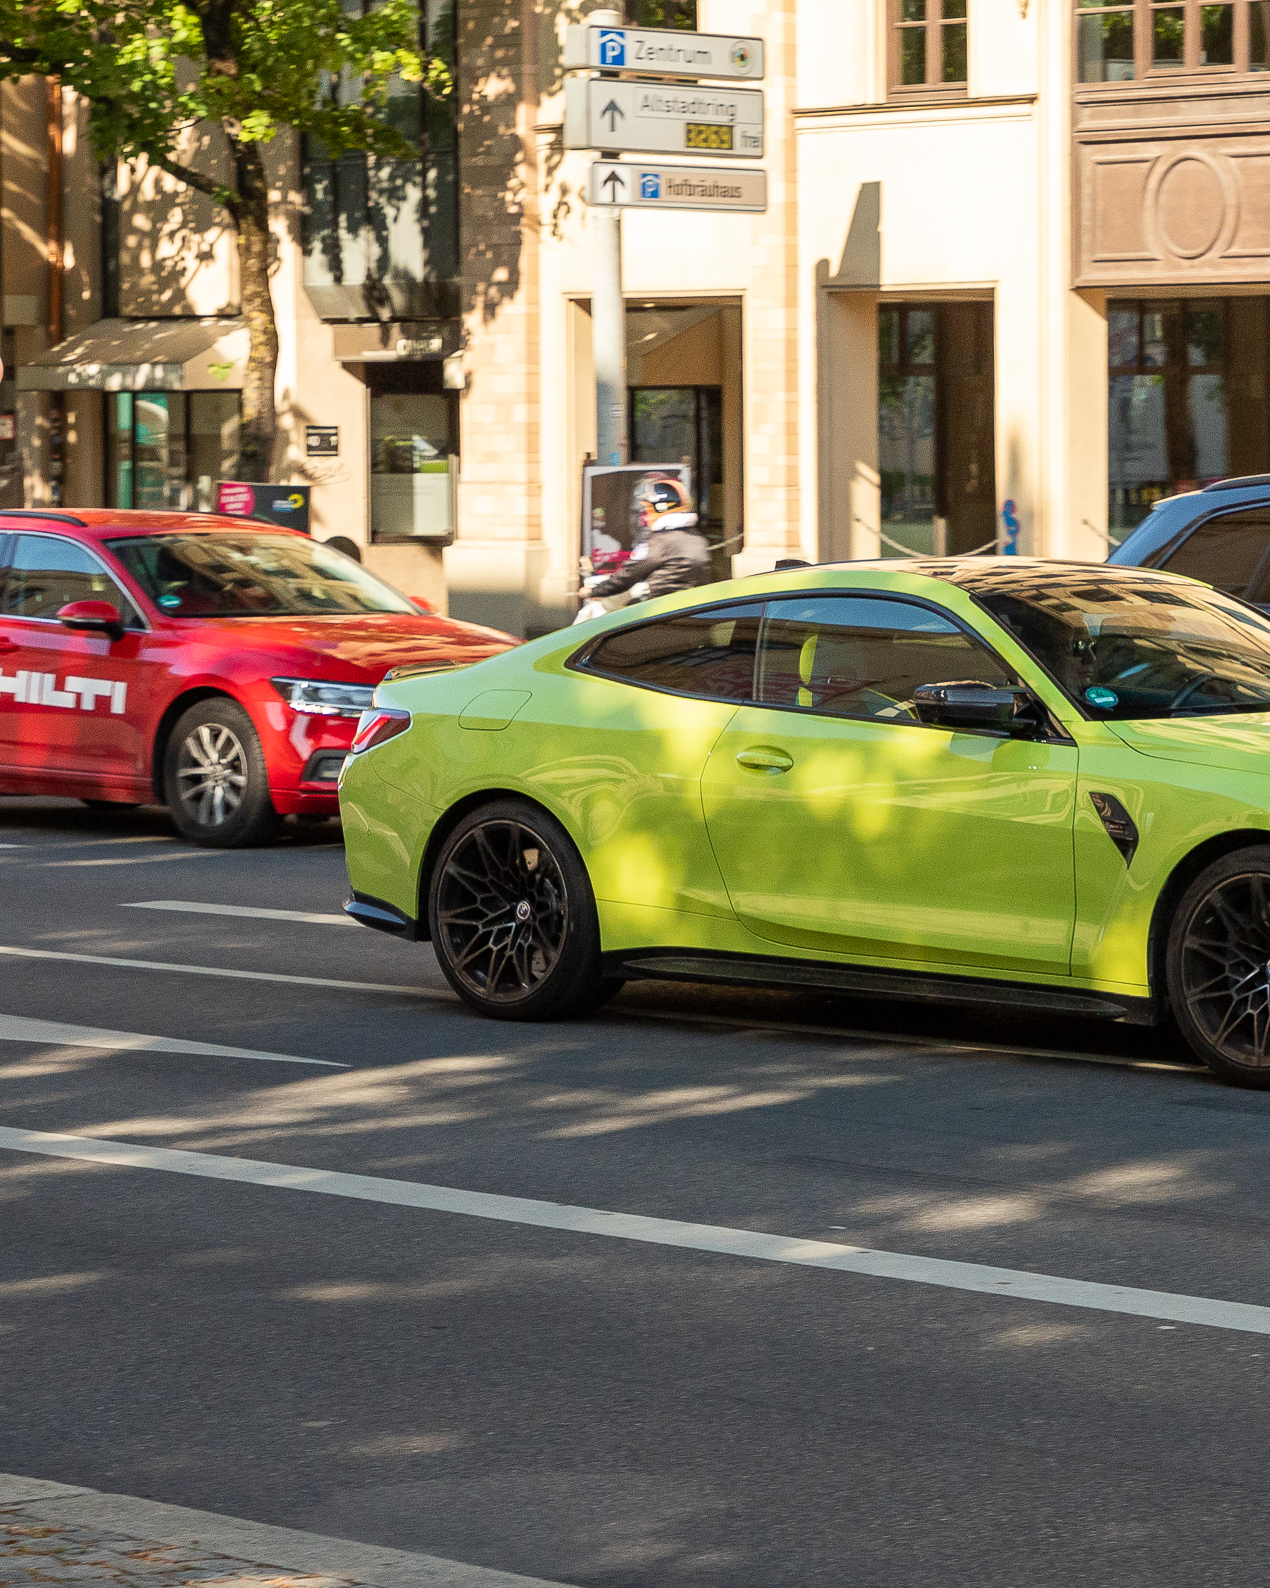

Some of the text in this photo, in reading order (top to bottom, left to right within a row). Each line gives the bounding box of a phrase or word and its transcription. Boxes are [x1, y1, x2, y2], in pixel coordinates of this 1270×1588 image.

[635, 40, 711, 64] Zentrum
[640, 94, 737, 122] Altstadtring
[665, 178, 744, 199] Hofbräuhaus
